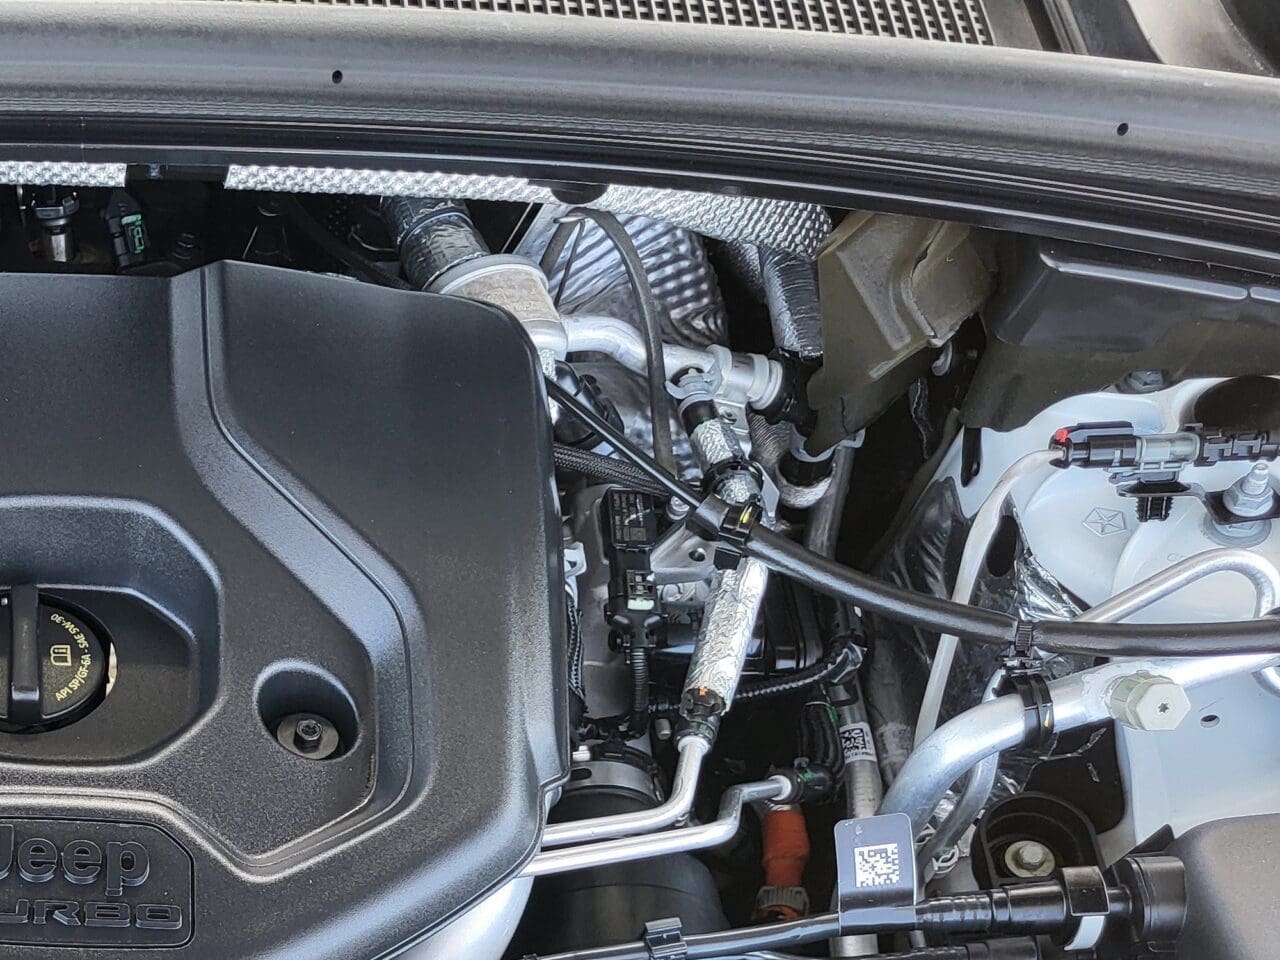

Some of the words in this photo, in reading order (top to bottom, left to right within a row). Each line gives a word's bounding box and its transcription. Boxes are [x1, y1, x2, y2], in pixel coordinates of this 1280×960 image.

[50, 613, 79, 635] 5W-30
[74, 632, 89, 652] SAE
[55, 688, 72, 702] API
